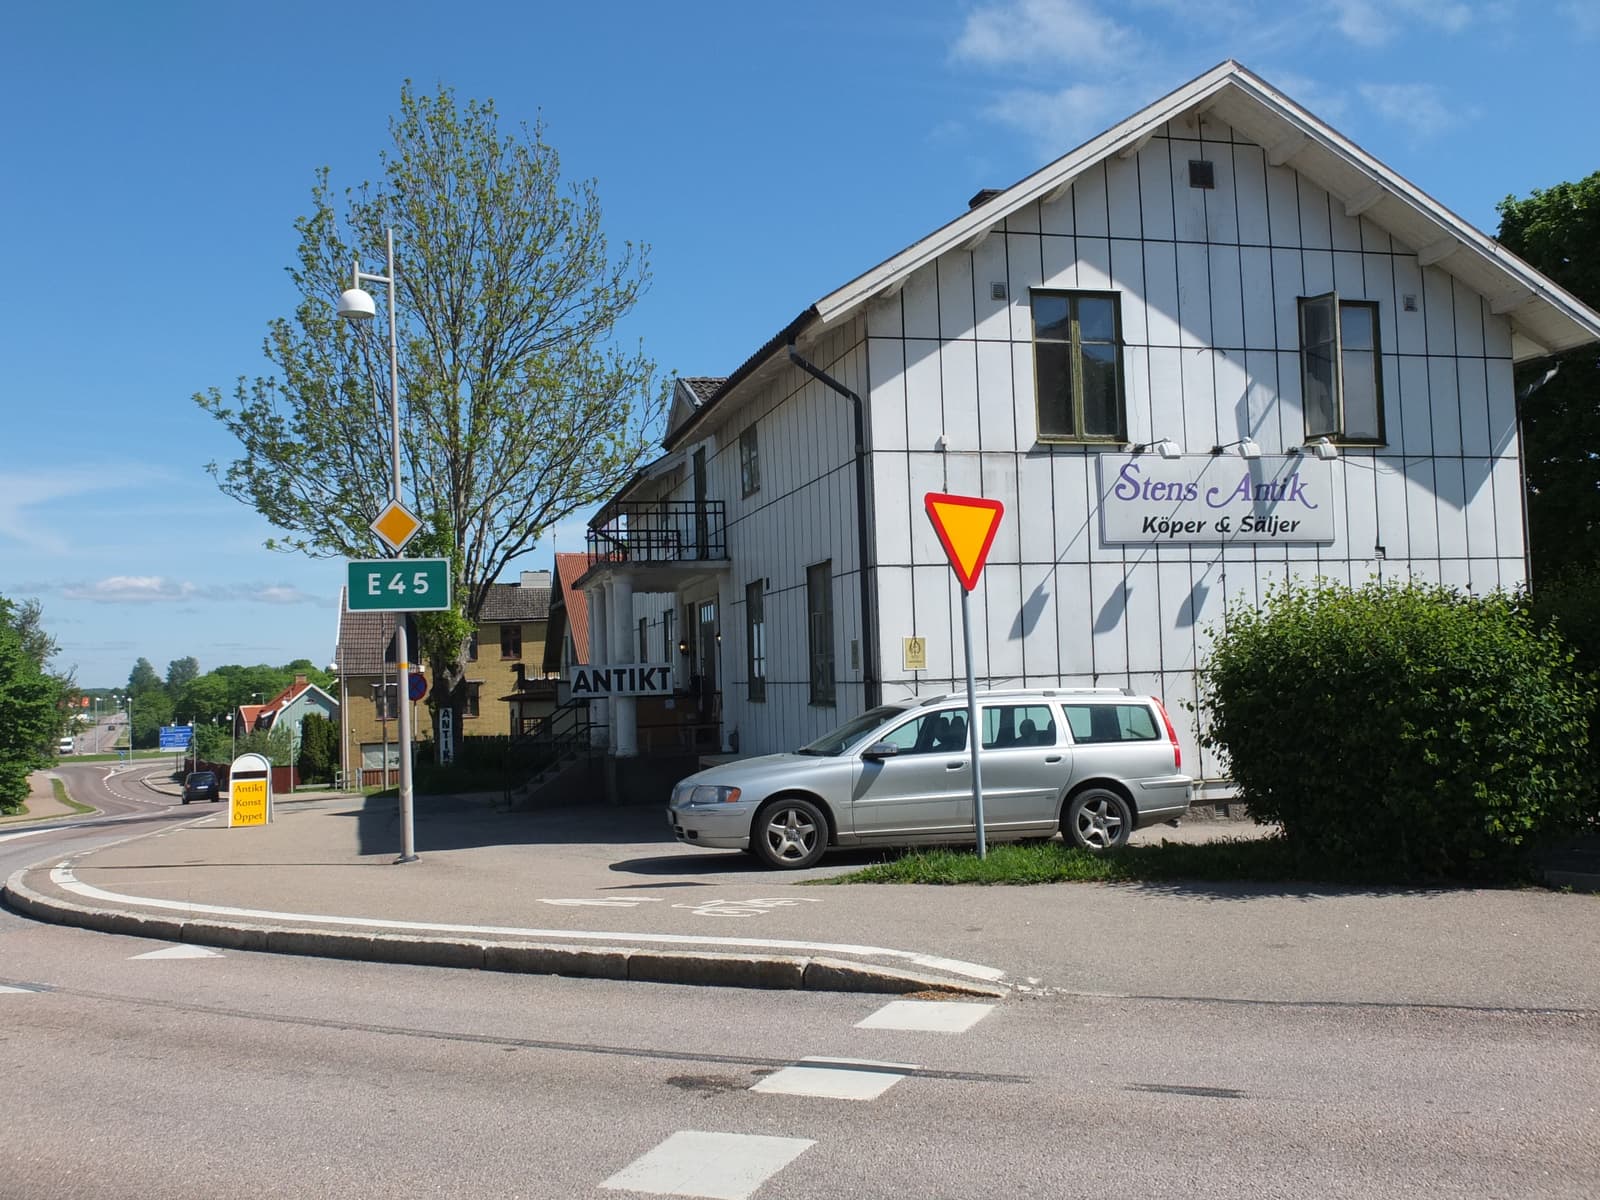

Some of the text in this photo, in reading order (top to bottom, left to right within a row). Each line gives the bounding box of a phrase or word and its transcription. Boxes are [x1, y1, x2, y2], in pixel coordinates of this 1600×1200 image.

[1115, 463, 1319, 510] Stens Antik
[1142, 514, 1301, 538] Köper & Säljer
[572, 667, 671, 693] ANTIKT
[235, 784, 263, 793] Antikt
[236, 799, 261, 807] Konst
[233, 811, 263, 823] Öppet
